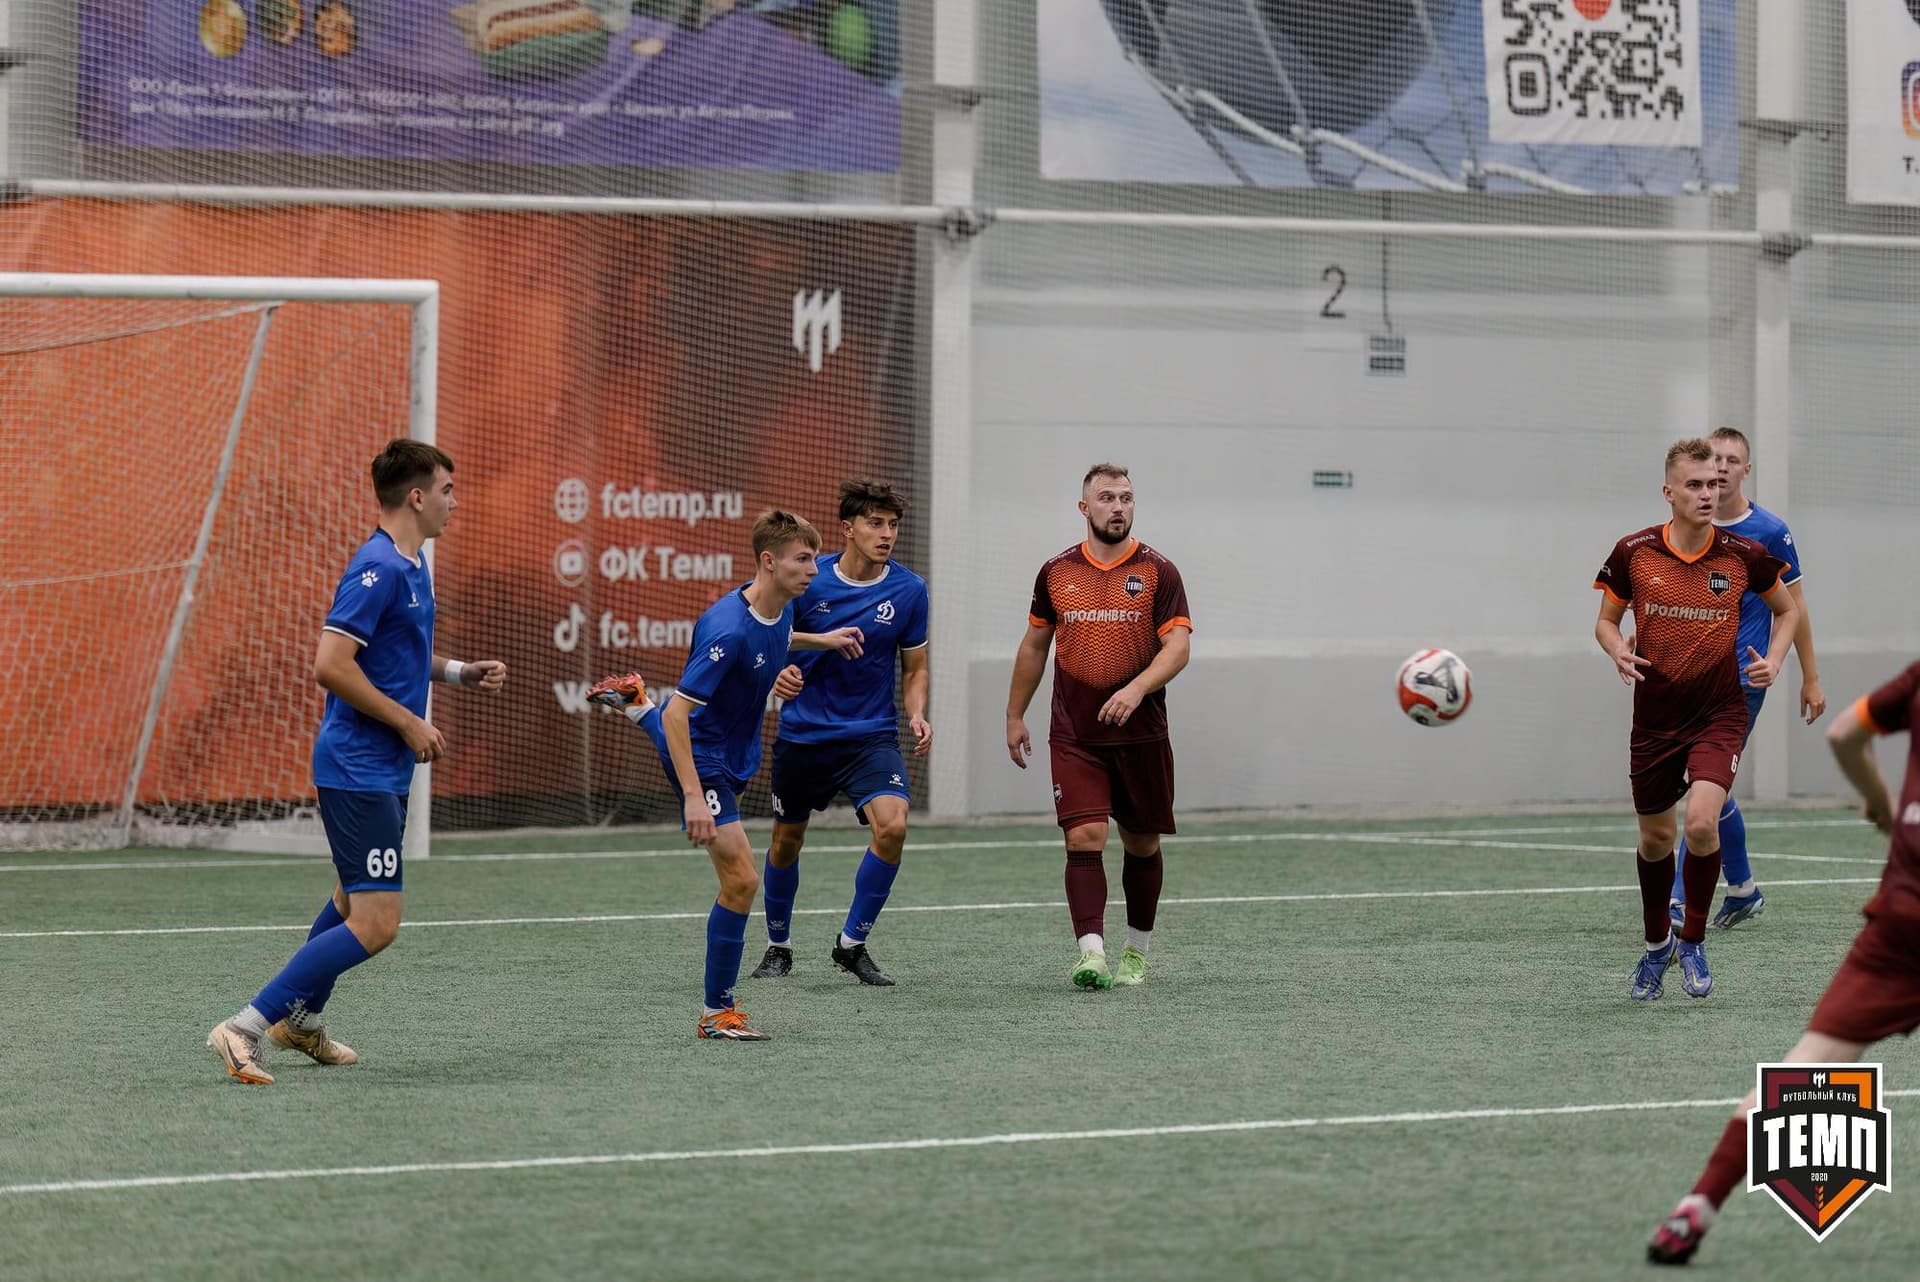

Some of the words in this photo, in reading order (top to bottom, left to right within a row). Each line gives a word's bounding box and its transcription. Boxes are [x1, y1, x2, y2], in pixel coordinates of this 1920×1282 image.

[1320, 264, 1347, 318] 2
[601, 483, 744, 527] fctemp.ru
[600, 546, 649, 582] ФК
[655, 546, 734, 581] Темп
[600, 610, 694, 648] fc.tem
[1064, 608, 1142, 625] ПРОДИНВЕСТ
[1731, 754, 1739, 773] 6
[366, 848, 398, 878] 69
